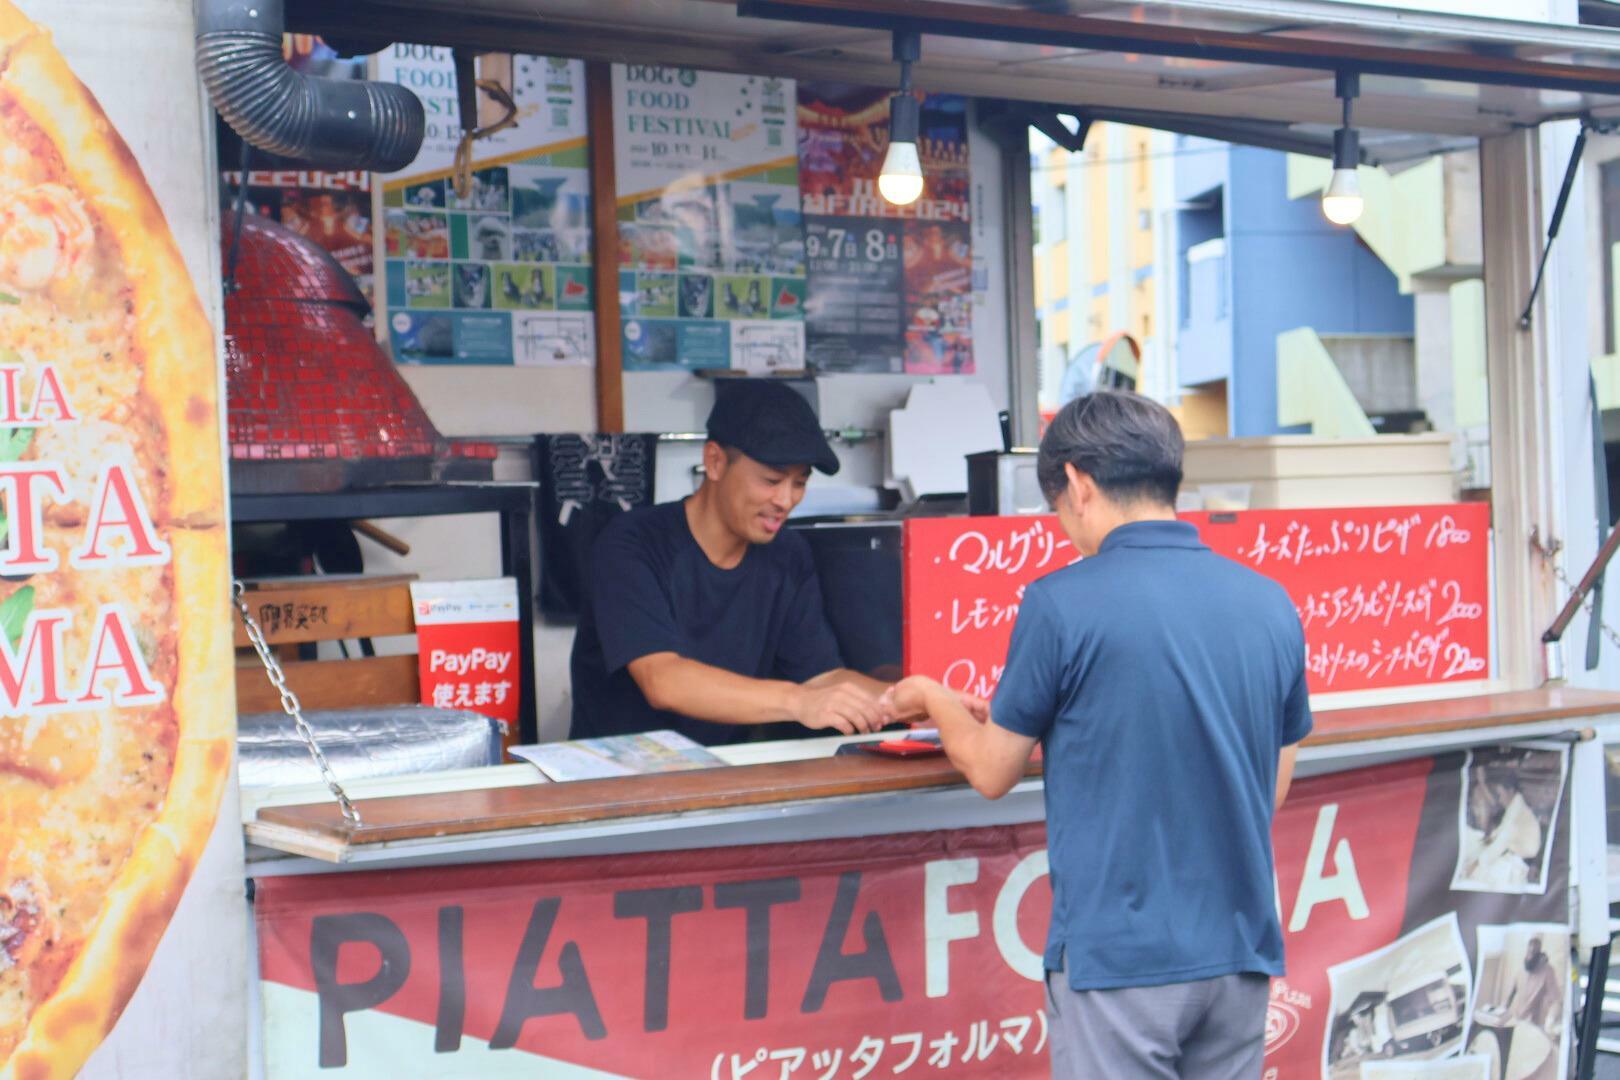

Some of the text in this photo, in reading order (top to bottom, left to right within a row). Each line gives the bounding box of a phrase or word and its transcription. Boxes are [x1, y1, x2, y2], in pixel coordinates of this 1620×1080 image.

[394, 42, 445, 62] DOG
[625, 64, 673, 84] DOG
[627, 89, 690, 110] FOOD
[430, 647, 512, 676] PayPay
[432, 680, 512, 709] 使えます
